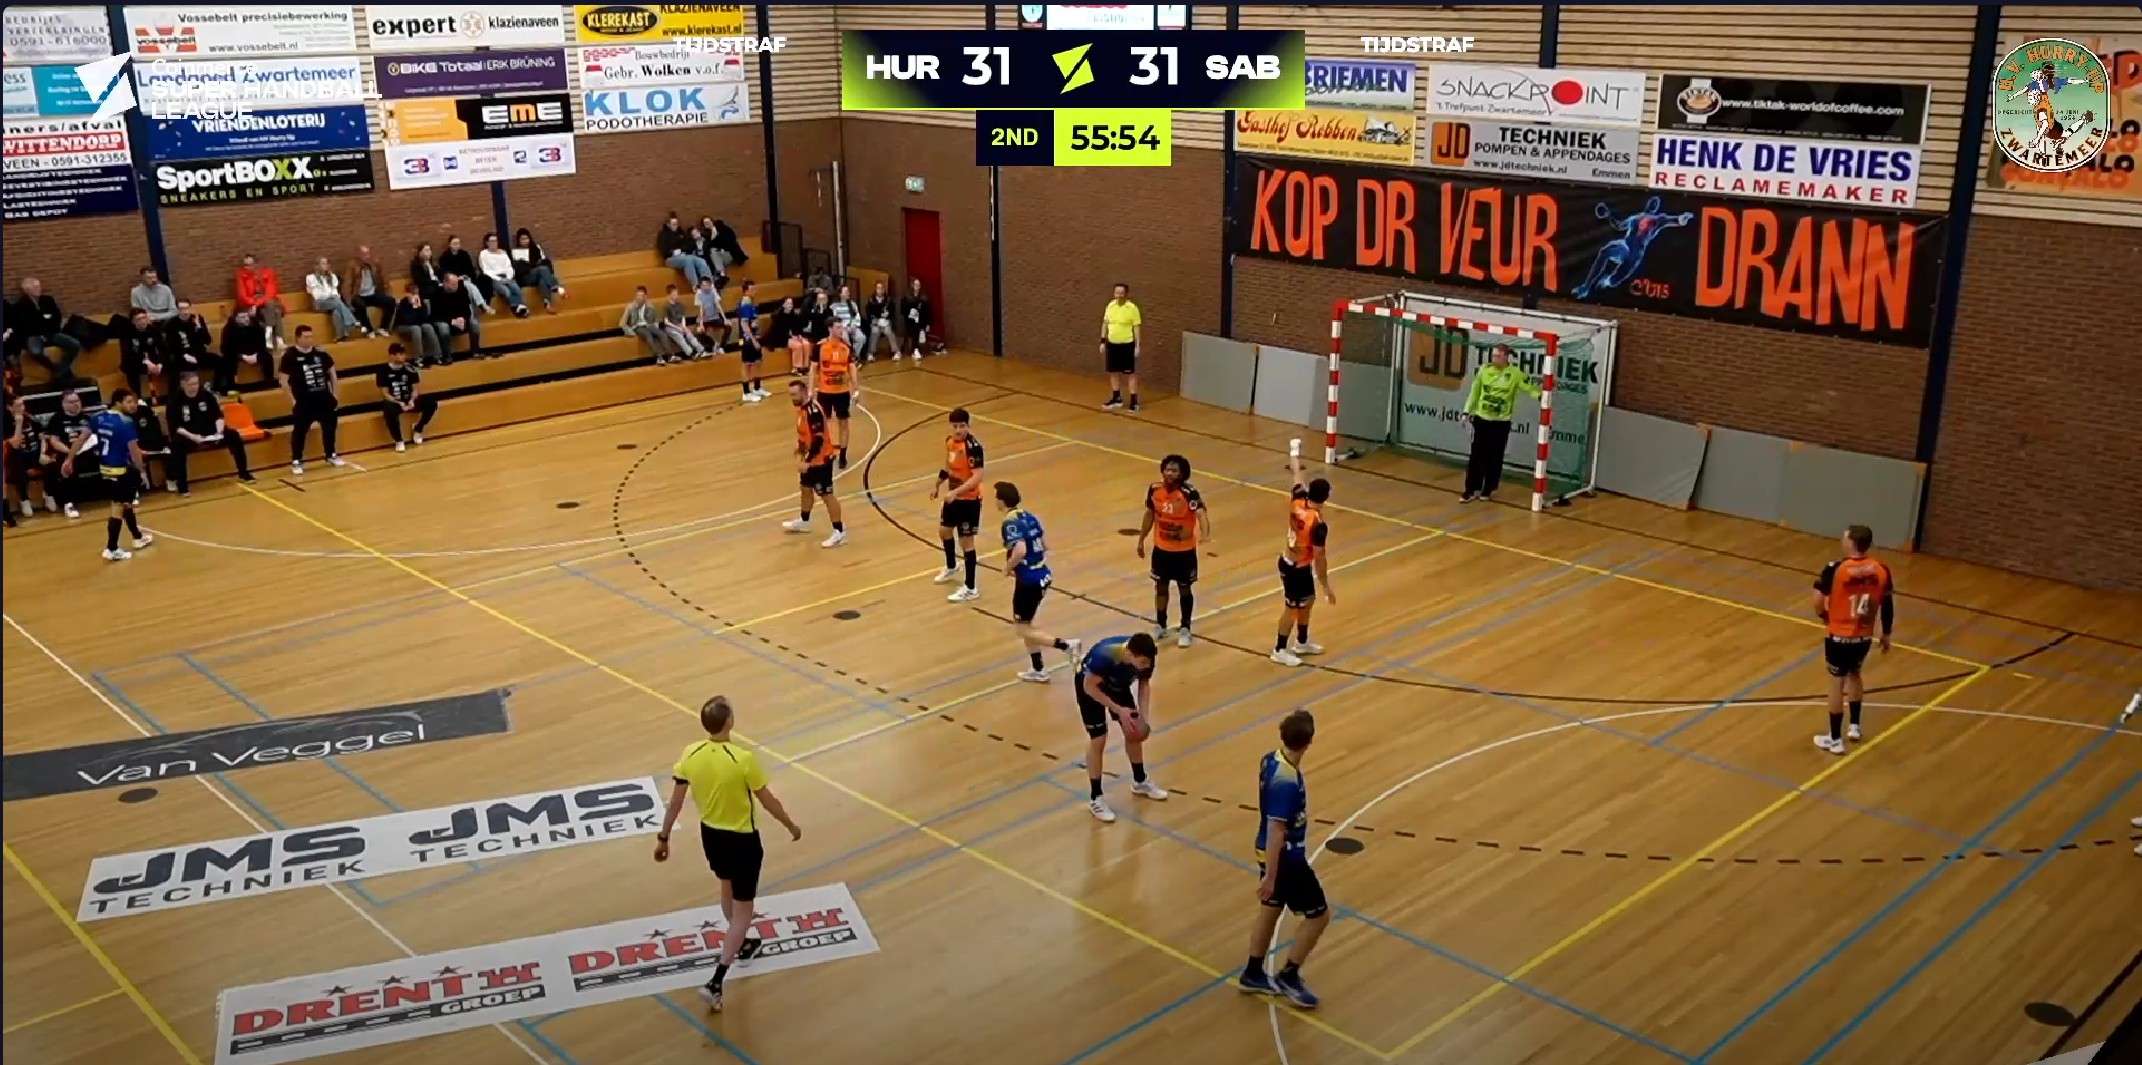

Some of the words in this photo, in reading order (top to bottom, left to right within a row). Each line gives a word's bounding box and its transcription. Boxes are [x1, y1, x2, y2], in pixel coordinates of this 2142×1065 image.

[177, 12, 238, 23] Vossebelt
[372, 16, 457, 37] expert
[488, 16, 559, 28] klazienaveen
[587, 12, 650, 27] KLEREKAST
[440, 61, 483, 73] Totaal
[604, 66, 638, 79] Gebr.
[641, 64, 691, 77] Wolken
[584, 87, 706, 116] KLOK
[1721, 98, 1905, 117] www.tiktak-worldofcoffee.com
[192, 113, 325, 133] VRIENDENLOTERIJ
[586, 112, 709, 131] PODOTHERAPIE
[1236, 111, 1297, 144] Gasthof
[3, 134, 122, 154] WITTENDORP
[1437, 122, 1471, 159] JD
[1499, 127, 1608, 150] TECHNIEK
[1474, 142, 1528, 156] POMPEN
[1542, 147, 1631, 164] APPENDAGES
[1473, 159, 1568, 174] www.jdtechniek.nl
[1591, 168, 1631, 180] Emmen
[1657, 138, 1743, 170] HENK
[1753, 144, 1797, 173] DE
[1809, 147, 1912, 181] VRIES
[156, 156, 313, 192] SportBOXX
[160, 189, 237, 204] SNEAKERS
[246, 187, 264, 198] EN
[272, 183, 316, 196] SPORT
[1655, 171, 1908, 204] RECLAMEMAKER
[1250, 169, 1339, 260] KOP
[1356, 177, 1416, 275] DR
[1440, 181, 1559, 293] VEUR
[1695, 206, 1918, 332] DRANN
[1848, 593, 1871, 618] 14
[77, 754, 197, 787] Van
[212, 723, 426, 769] Veggel
[409, 783, 656, 847] JMS
[410, 814, 660, 863] TECHNIEK
[93, 827, 366, 894] JMS
[89, 859, 365, 913] TECHNIEK
[763, 930, 855, 956] GROEP
[441, 985, 544, 1016] GROEP
